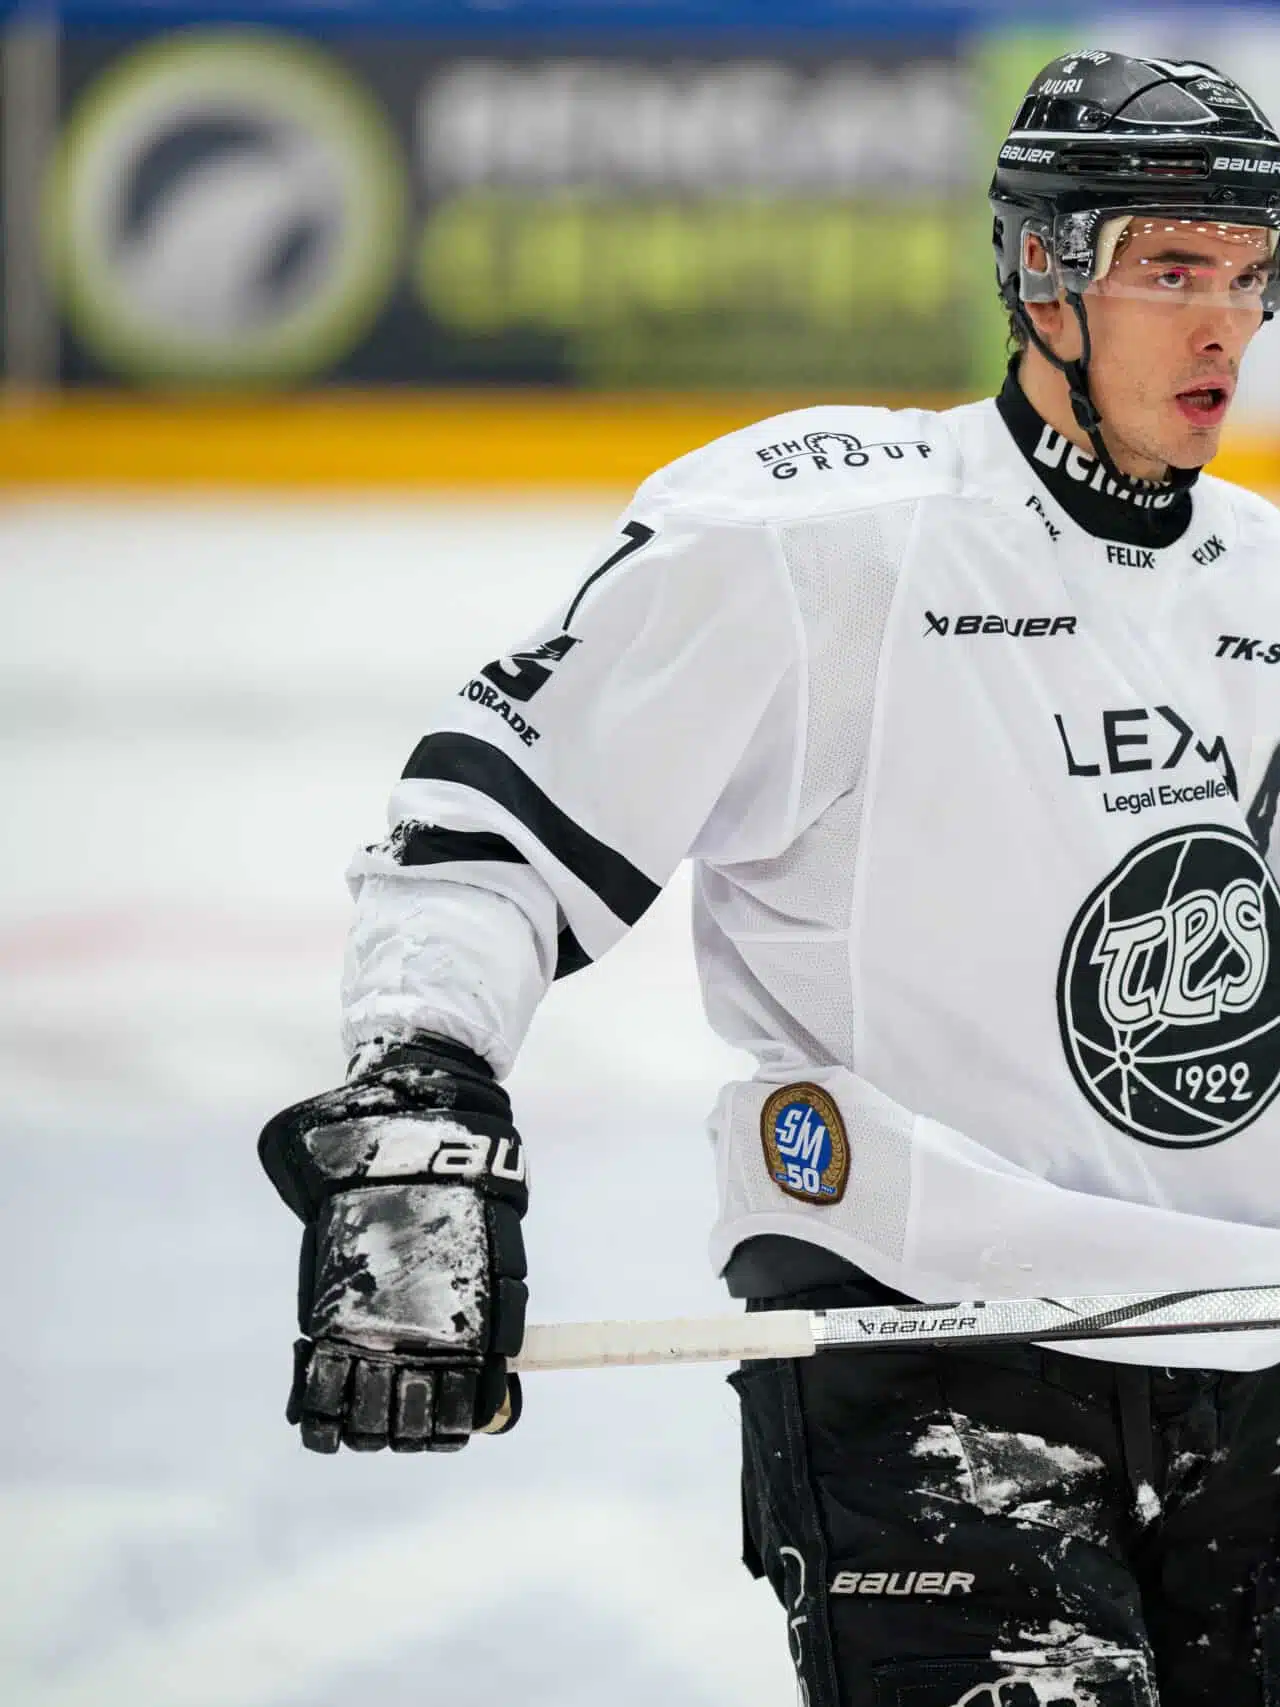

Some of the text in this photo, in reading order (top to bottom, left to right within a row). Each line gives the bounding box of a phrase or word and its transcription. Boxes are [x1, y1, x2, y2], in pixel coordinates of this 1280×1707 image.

[1038, 78, 1084, 96] JUURI
[1000, 143, 1056, 164] BAUER
[756, 440, 803, 462] ETH
[771, 444, 932, 480] GROUP
[1106, 544, 1155, 569] FELIX
[953, 615, 1078, 638] BAUER
[1103, 786, 1156, 814] Legal
[1091, 879, 1267, 1029] TPS
[1175, 1061, 1253, 1104] 1922
[775, 1107, 827, 1169] SM
[786, 1162, 820, 1194] 50
[878, 1316, 977, 1335] BAUER
[829, 1571, 976, 1596] BAUER
